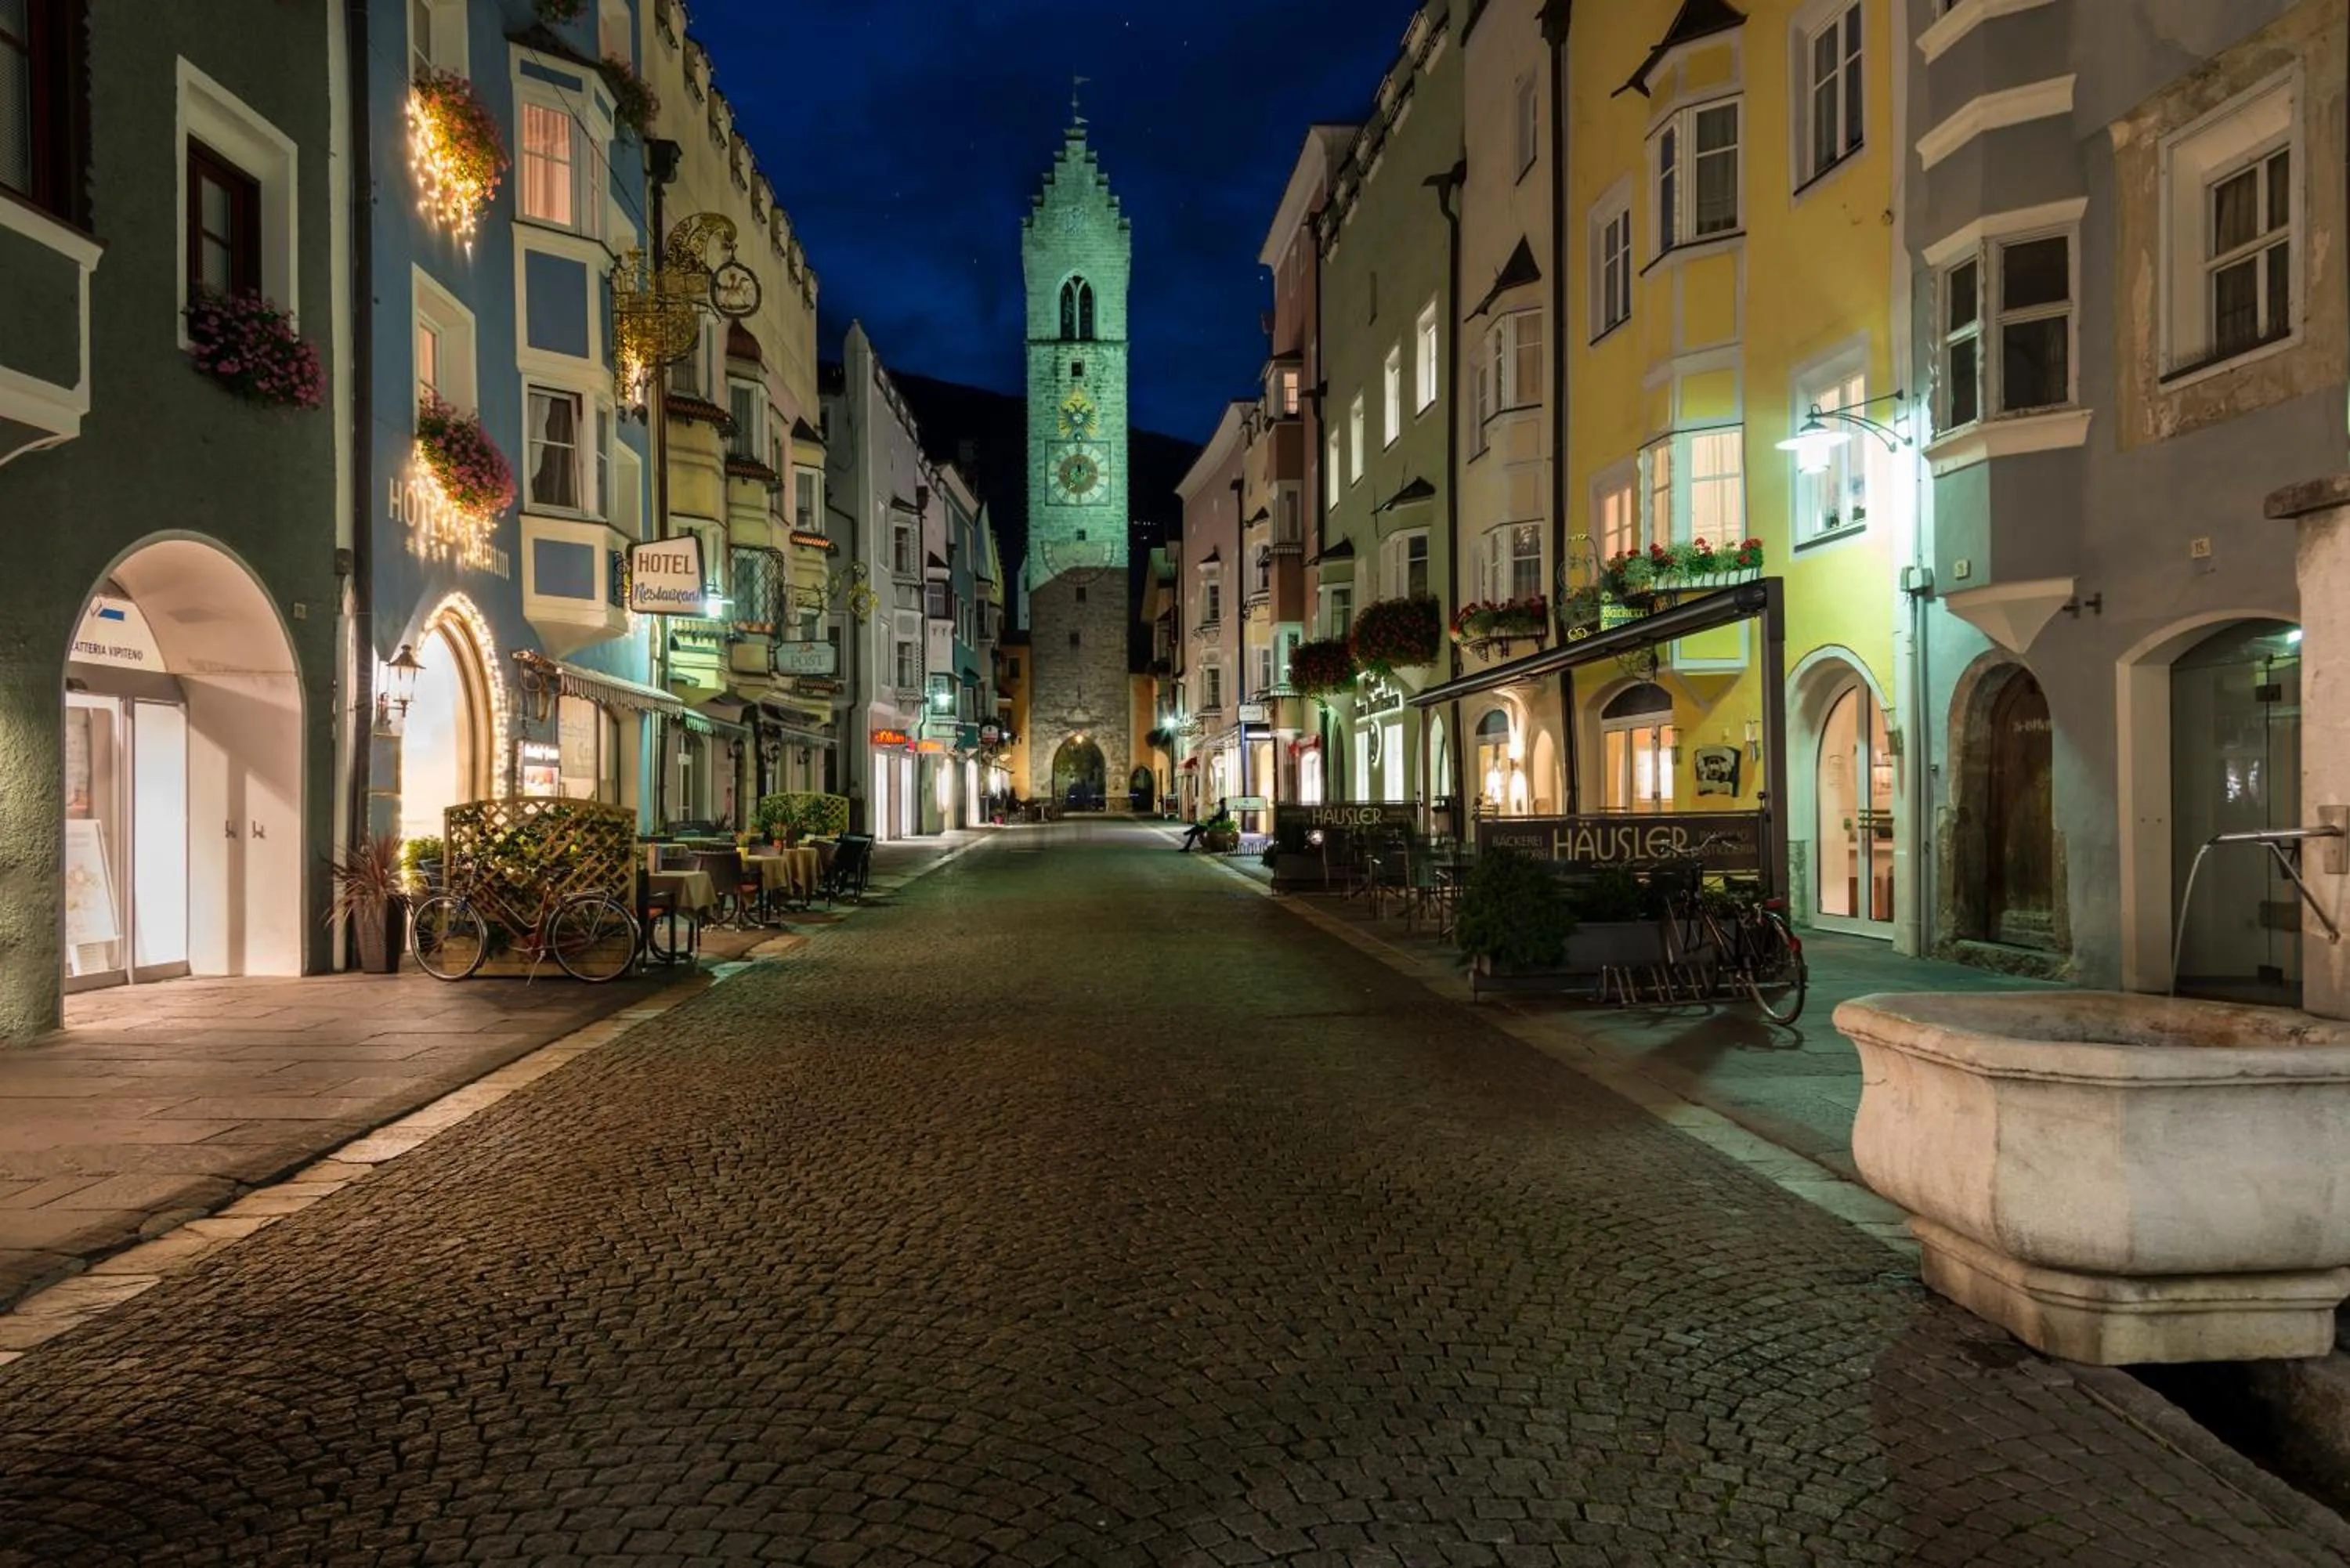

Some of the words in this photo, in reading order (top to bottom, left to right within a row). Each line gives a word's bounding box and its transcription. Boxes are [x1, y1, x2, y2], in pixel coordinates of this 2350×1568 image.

[638, 552, 695, 575] HOTEL
[634, 582, 701, 604] Restaurant
[109, 646, 143, 661] VIPITENO
[790, 654, 822, 668] POST
[1553, 822, 1694, 861] HÄUSLER
